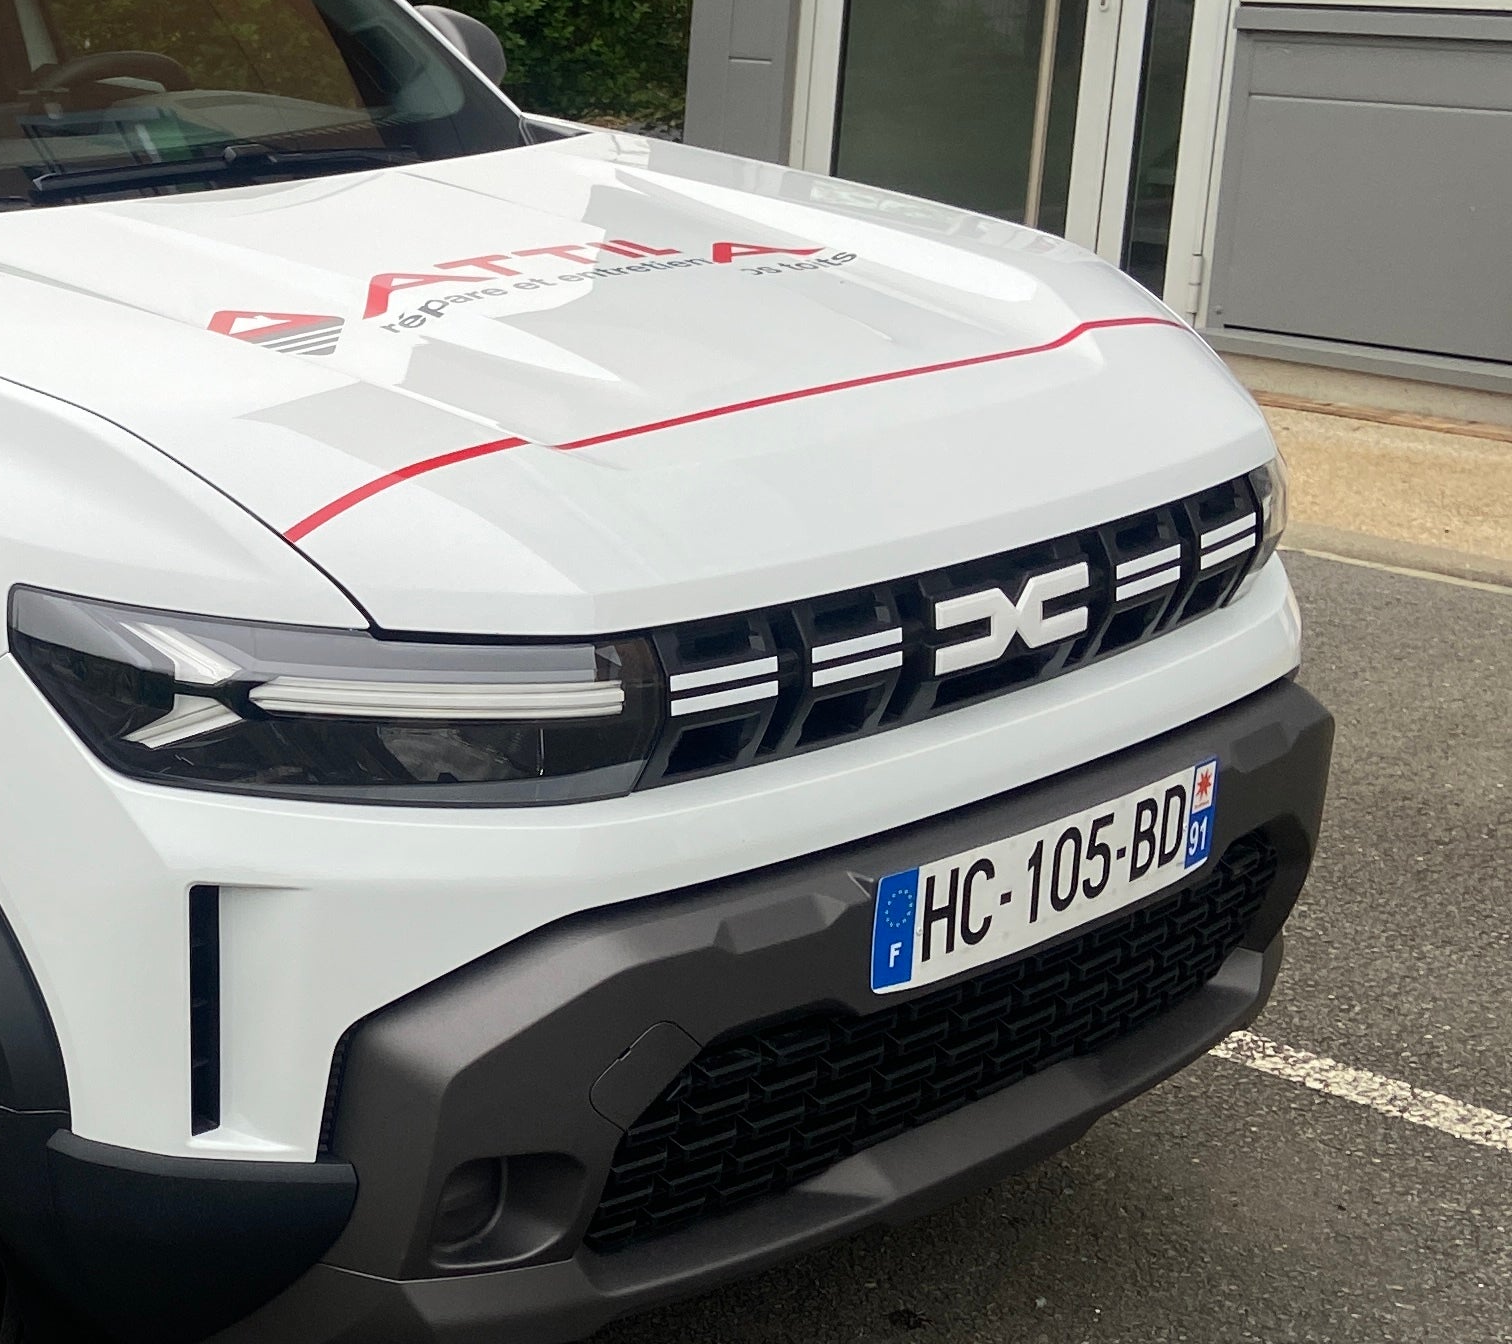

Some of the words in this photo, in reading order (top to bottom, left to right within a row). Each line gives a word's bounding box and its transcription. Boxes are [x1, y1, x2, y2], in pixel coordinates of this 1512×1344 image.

[380, 288, 508, 333] répare
[513, 278, 557, 290] et
[558, 256, 713, 283] entretien
[1188, 815, 1209, 857] 91
[888, 941, 902, 968] F
